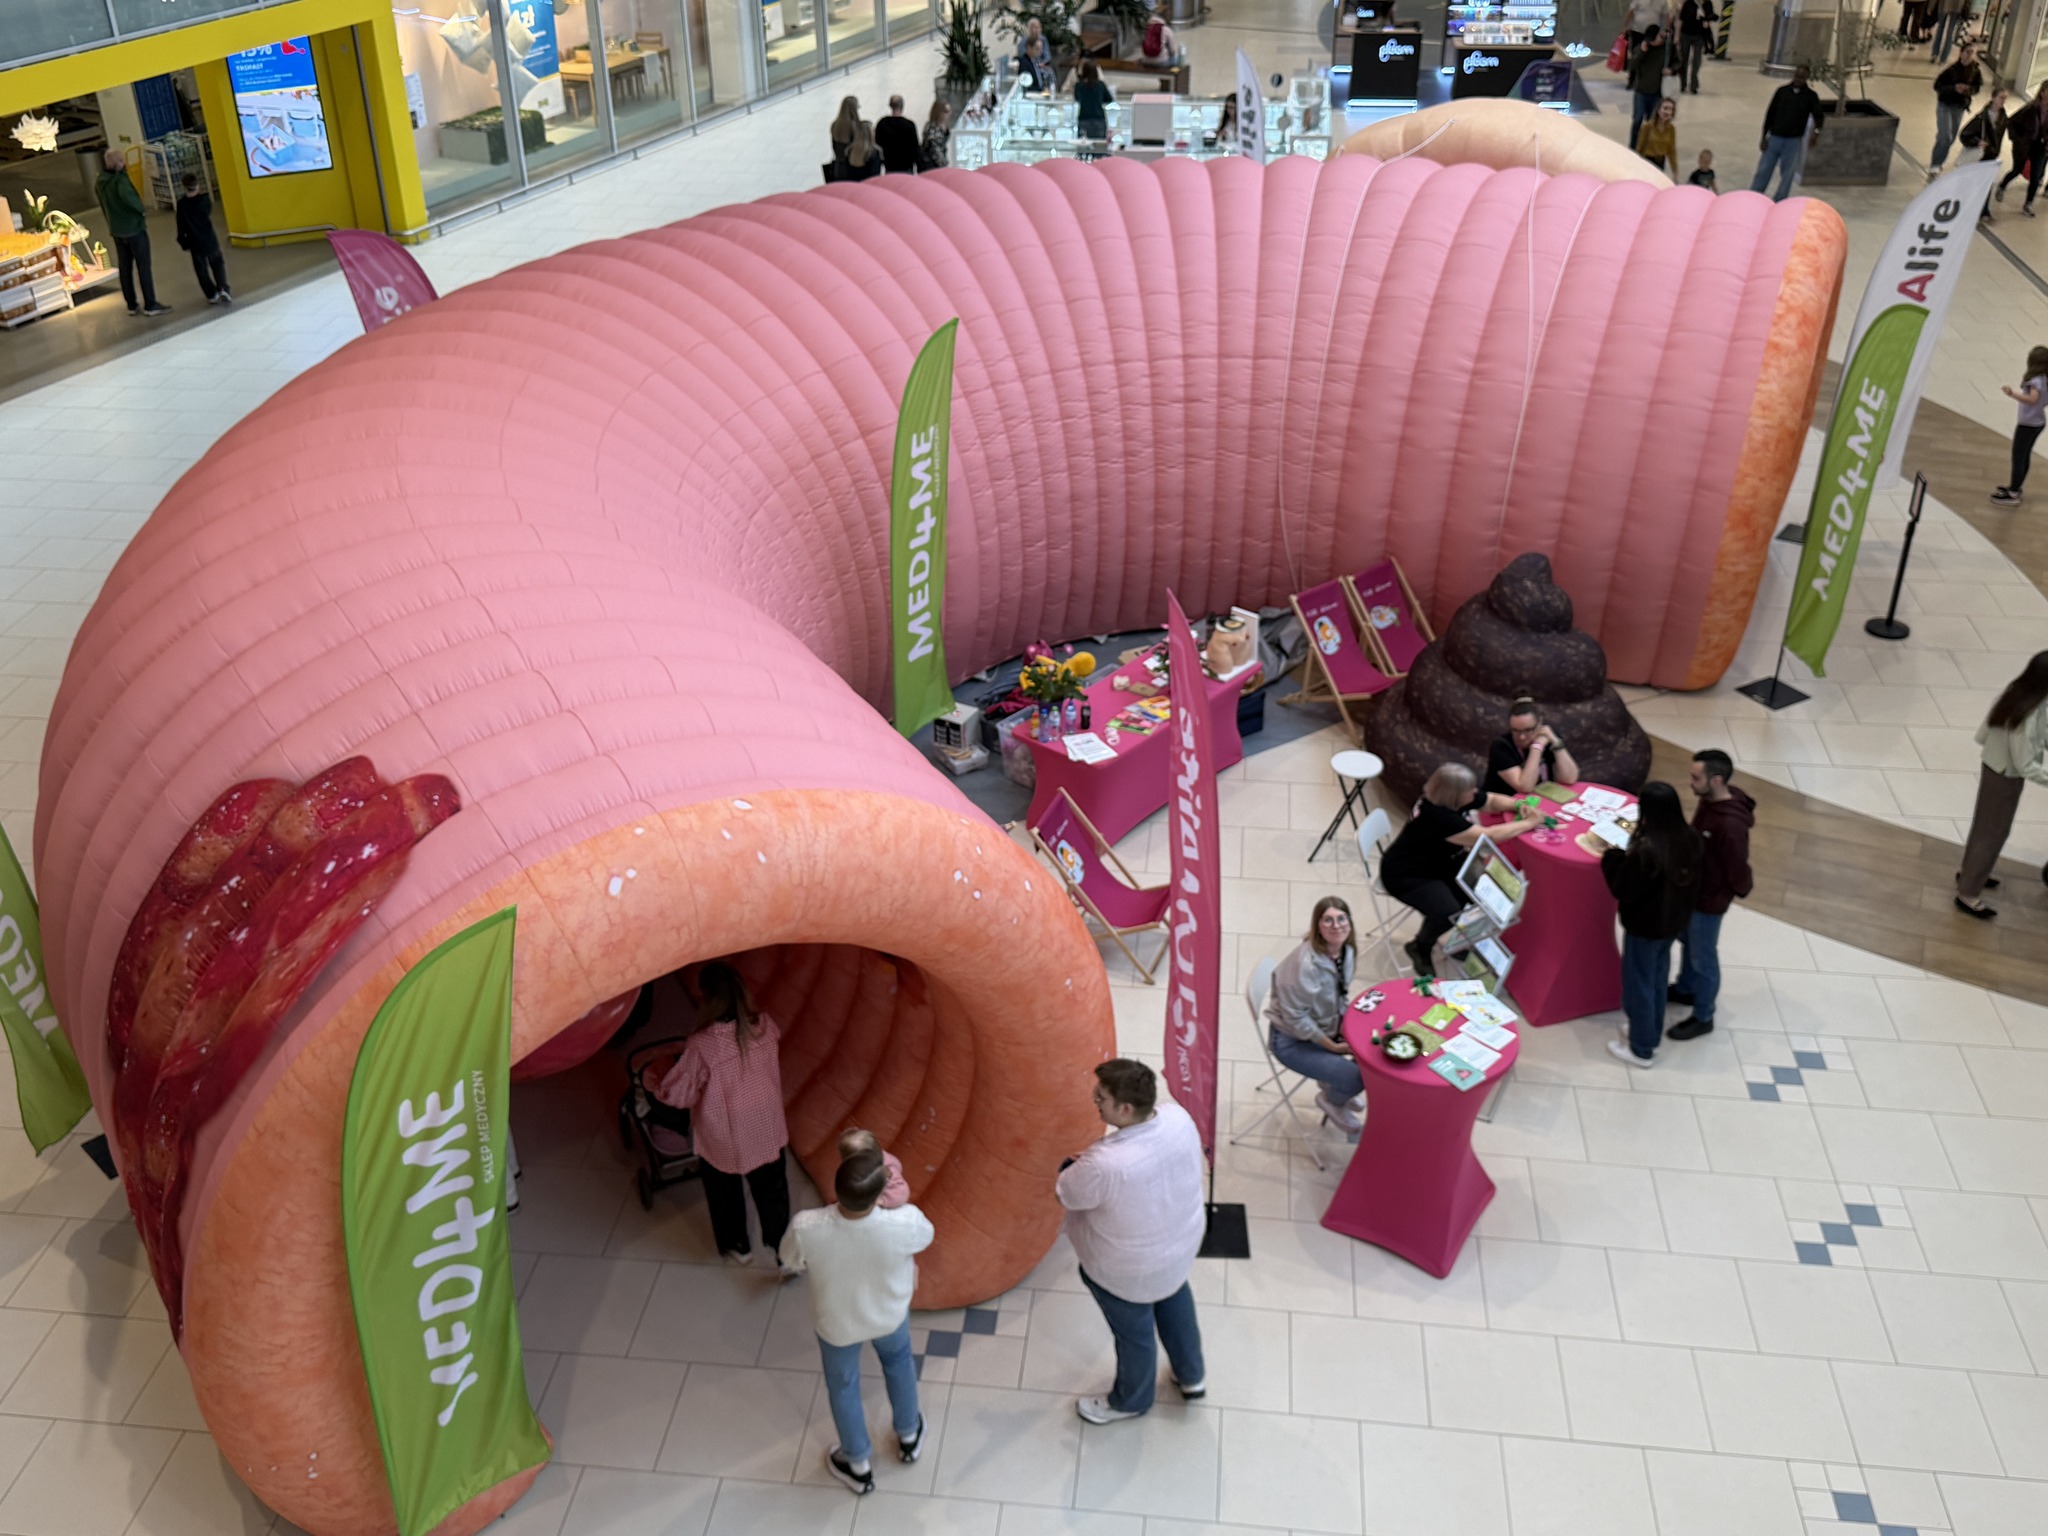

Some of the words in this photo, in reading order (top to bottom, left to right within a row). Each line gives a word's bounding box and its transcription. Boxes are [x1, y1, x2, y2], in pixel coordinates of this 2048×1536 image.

[1897, 199, 1960, 303] Alife
[1812, 377, 1886, 602] MED4ME
[907, 425, 936, 662] MED4ME
[472, 1069, 491, 1143] MEDYCZNY
[480, 1143, 495, 1184] SKLEP
